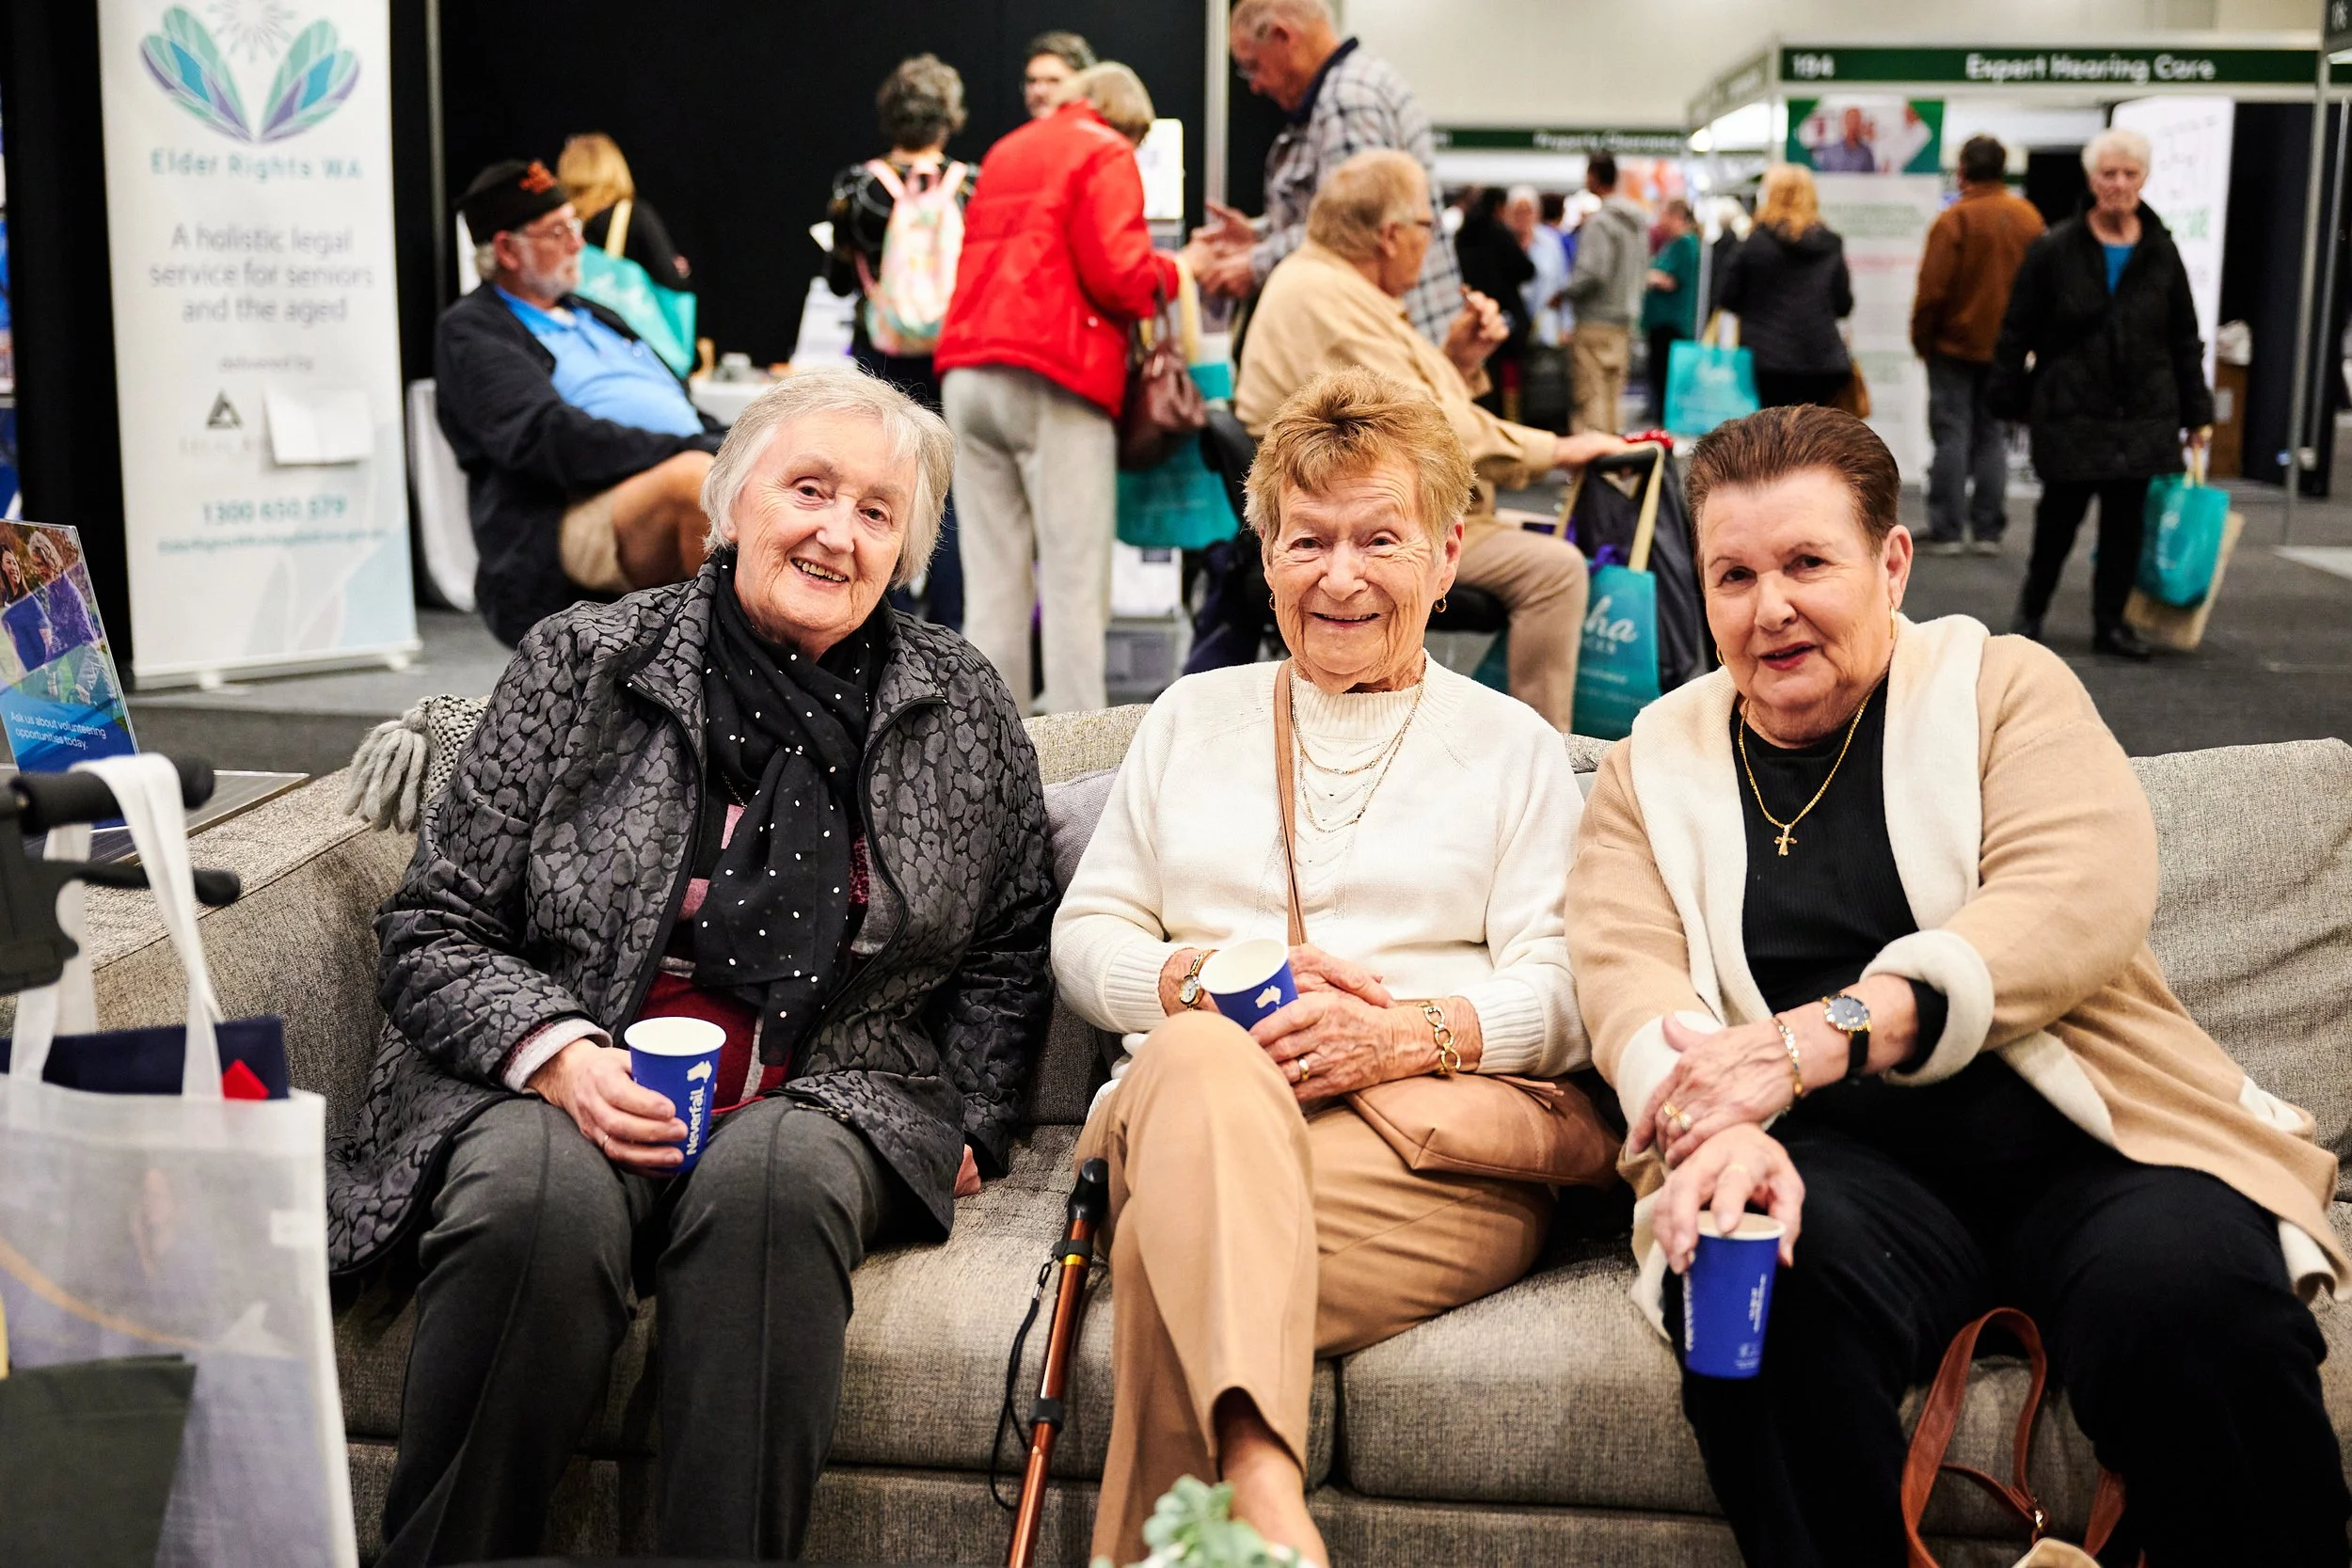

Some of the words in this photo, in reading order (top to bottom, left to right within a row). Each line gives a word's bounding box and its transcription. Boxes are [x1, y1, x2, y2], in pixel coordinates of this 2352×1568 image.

[1965, 54, 2046, 83] Expert
[2050, 54, 2150, 84] Hearing
[2153, 54, 2217, 80] Care
[151, 148, 216, 175] Elder
[229, 153, 312, 182] Rights
[324, 159, 362, 178] WA
[171, 224, 189, 250] A
[196, 223, 284, 253] holistic
[292, 225, 353, 259] legal
[150, 263, 237, 287] service
[245, 259, 278, 287] for
[286, 265, 373, 288] seniors
[183, 295, 228, 323] and
[236, 294, 278, 322] the
[283, 296, 347, 329] aged
[202, 500, 254, 524] 1300
[10, 712, 25, 723] Ask
[36, 716, 57, 729] about
[57, 721, 106, 739] volunteering
[15, 728, 64, 744] opportunities
[64, 736, 89, 751] today.
[686, 1085, 705, 1155] Neverfail
